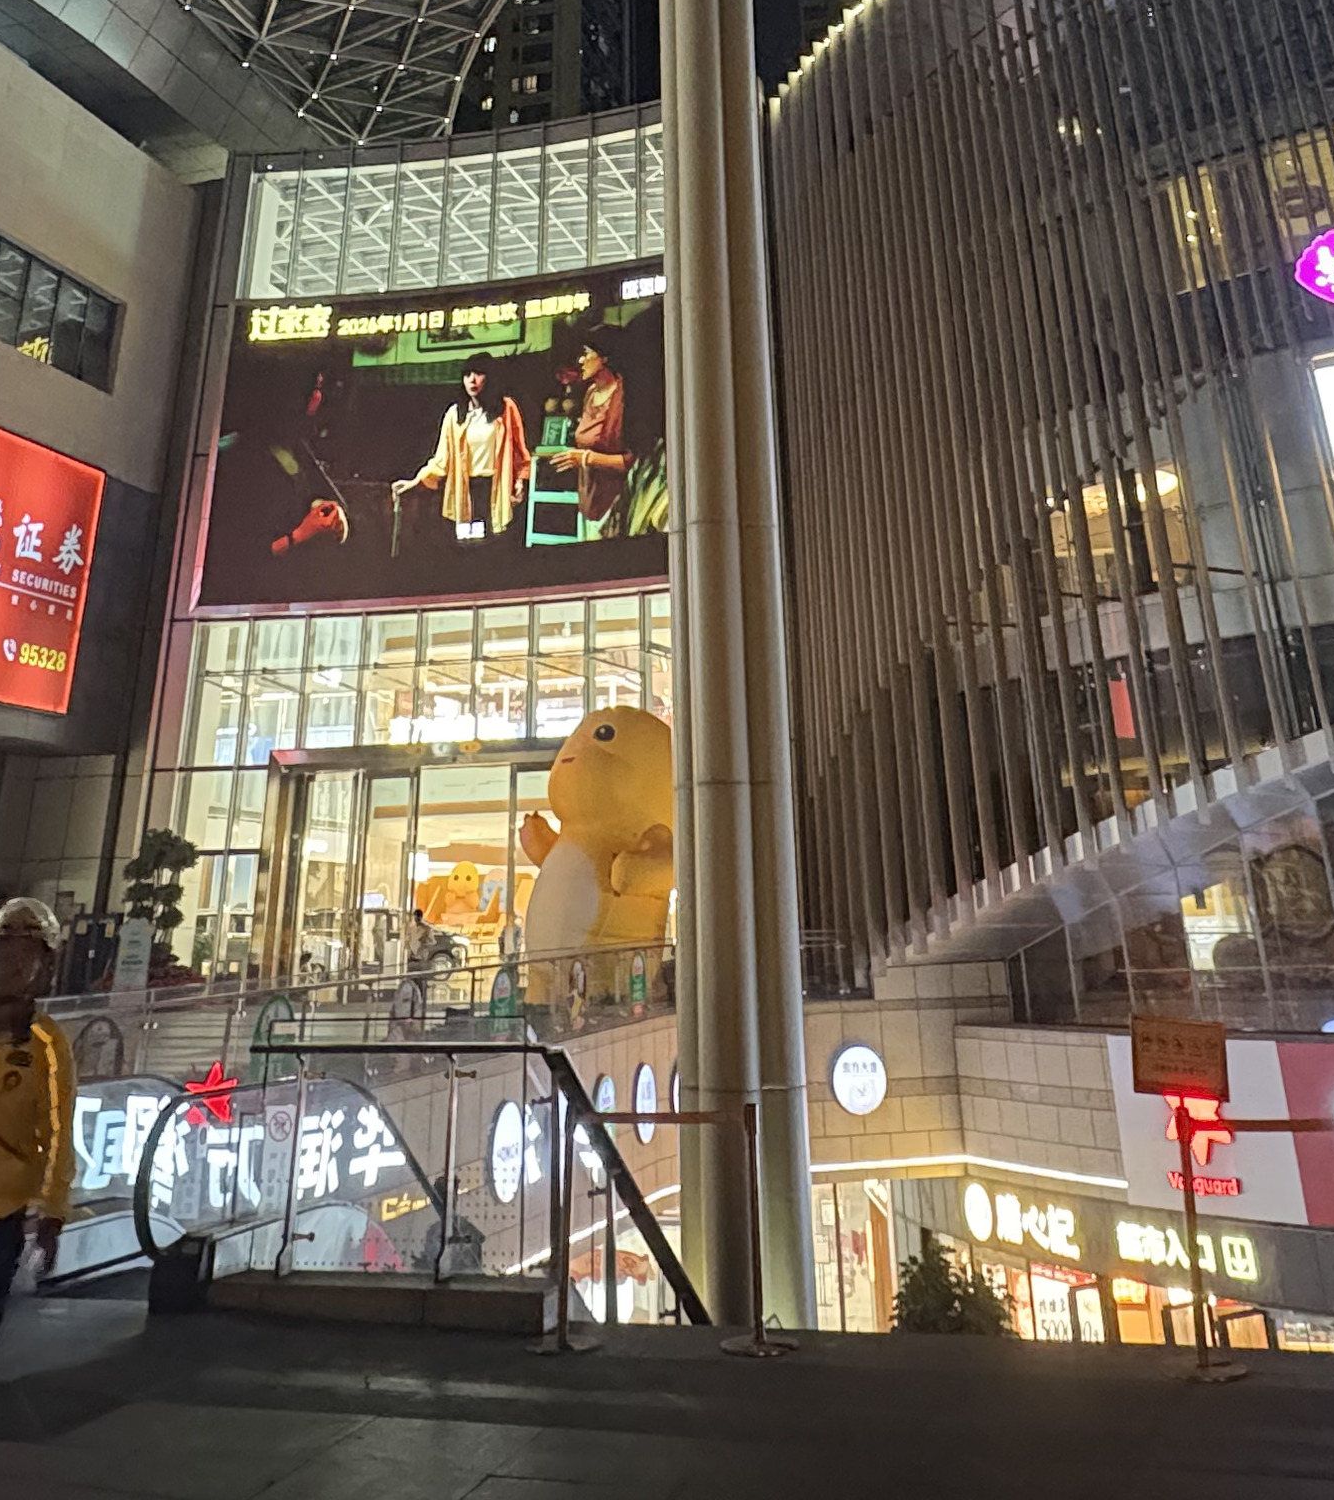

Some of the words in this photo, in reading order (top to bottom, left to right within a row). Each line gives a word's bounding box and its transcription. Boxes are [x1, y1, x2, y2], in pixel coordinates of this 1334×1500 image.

[11, 568, 78, 599] SECURITIES
[18, 642, 67, 672] 95328
[1167, 1171, 1241, 1198] Vaguard
